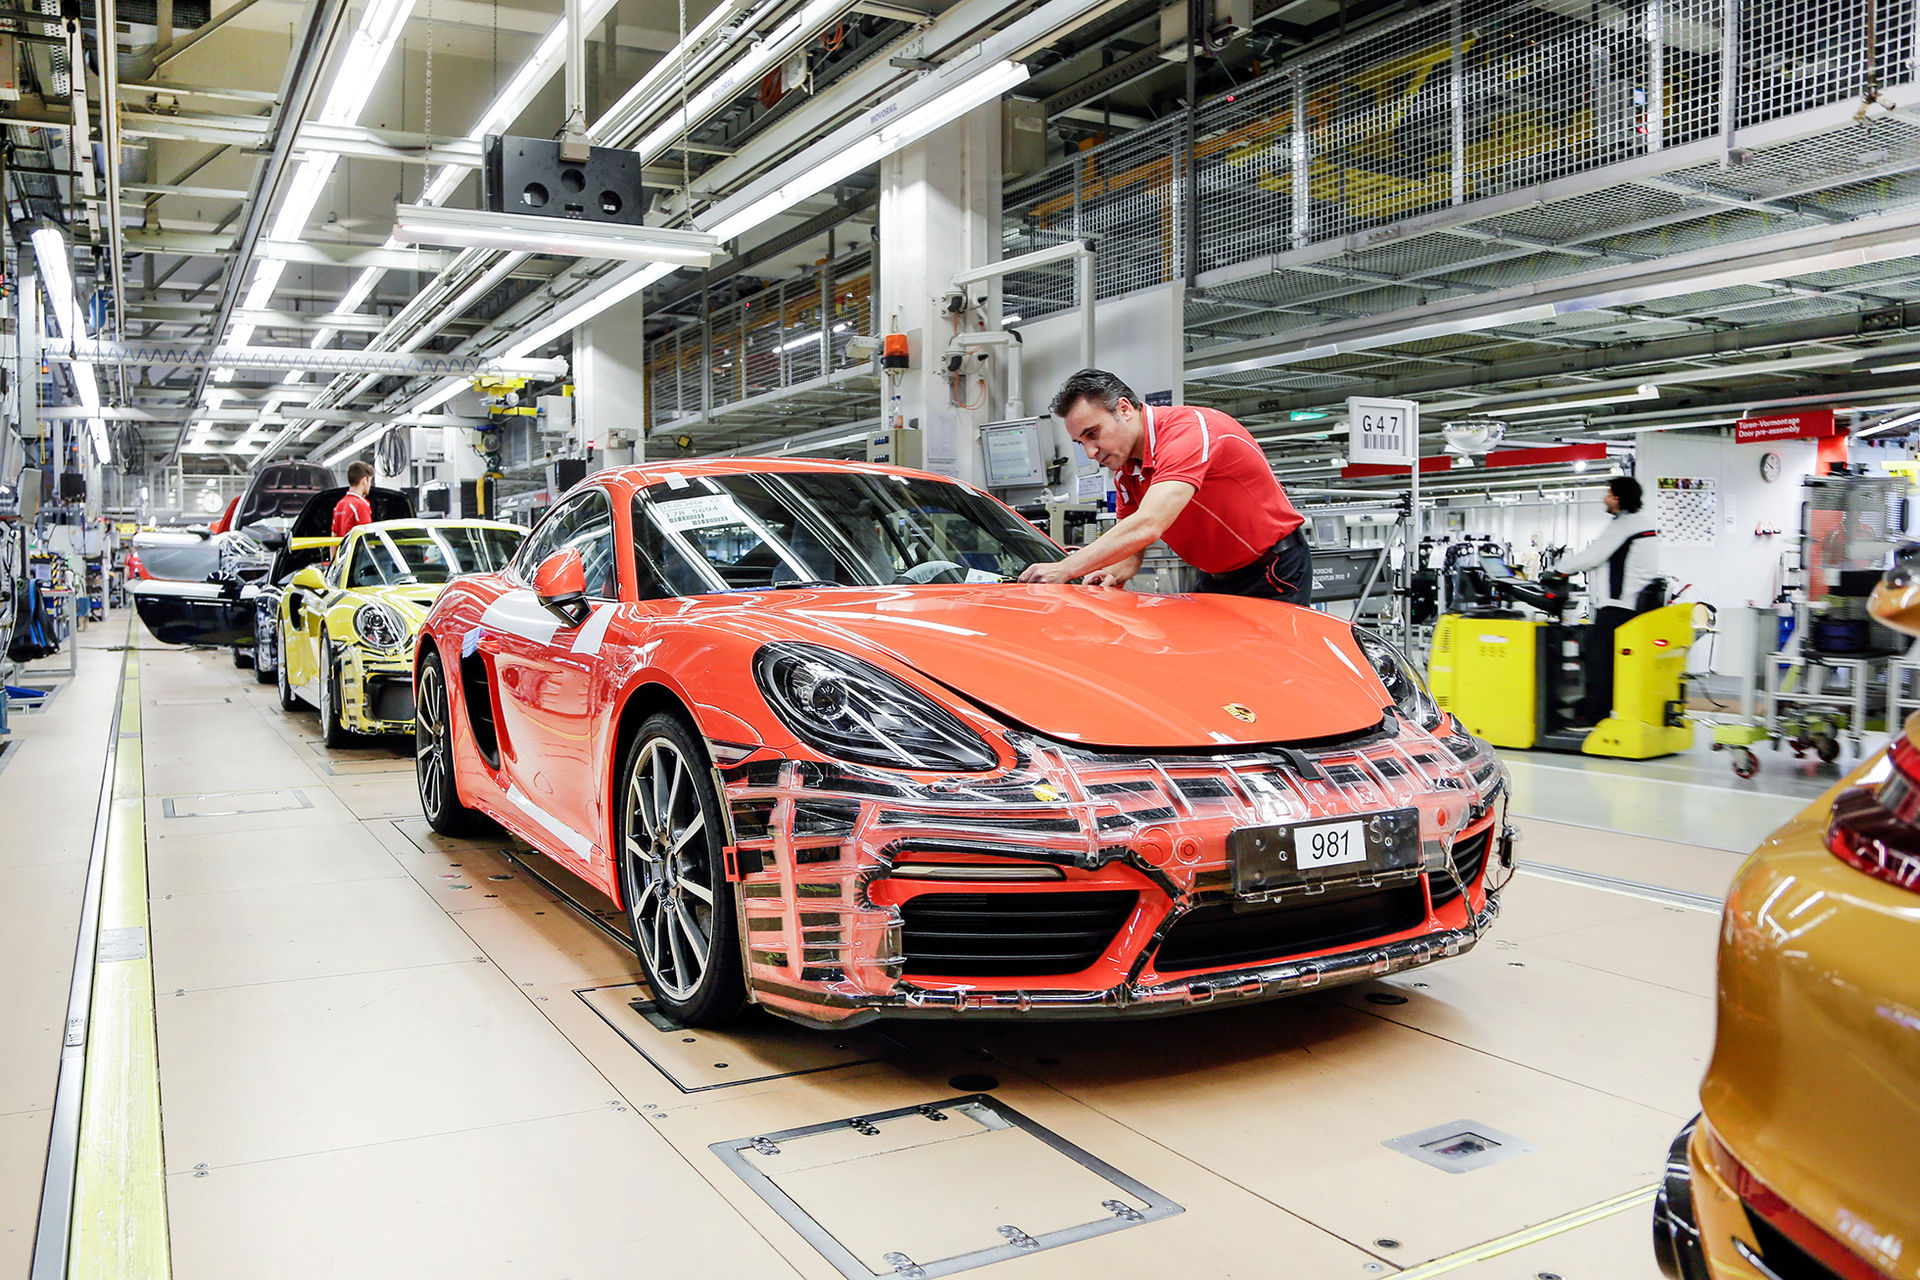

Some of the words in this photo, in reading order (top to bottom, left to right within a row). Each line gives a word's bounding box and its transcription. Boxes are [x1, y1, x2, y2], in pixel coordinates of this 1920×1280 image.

[870, 103, 898, 124] MOVORAIL
[1738, 418, 1800, 429] Türen-Vormontage
[1755, 426, 1800, 438] pre-assembly
[1311, 829, 1349, 860] 981
